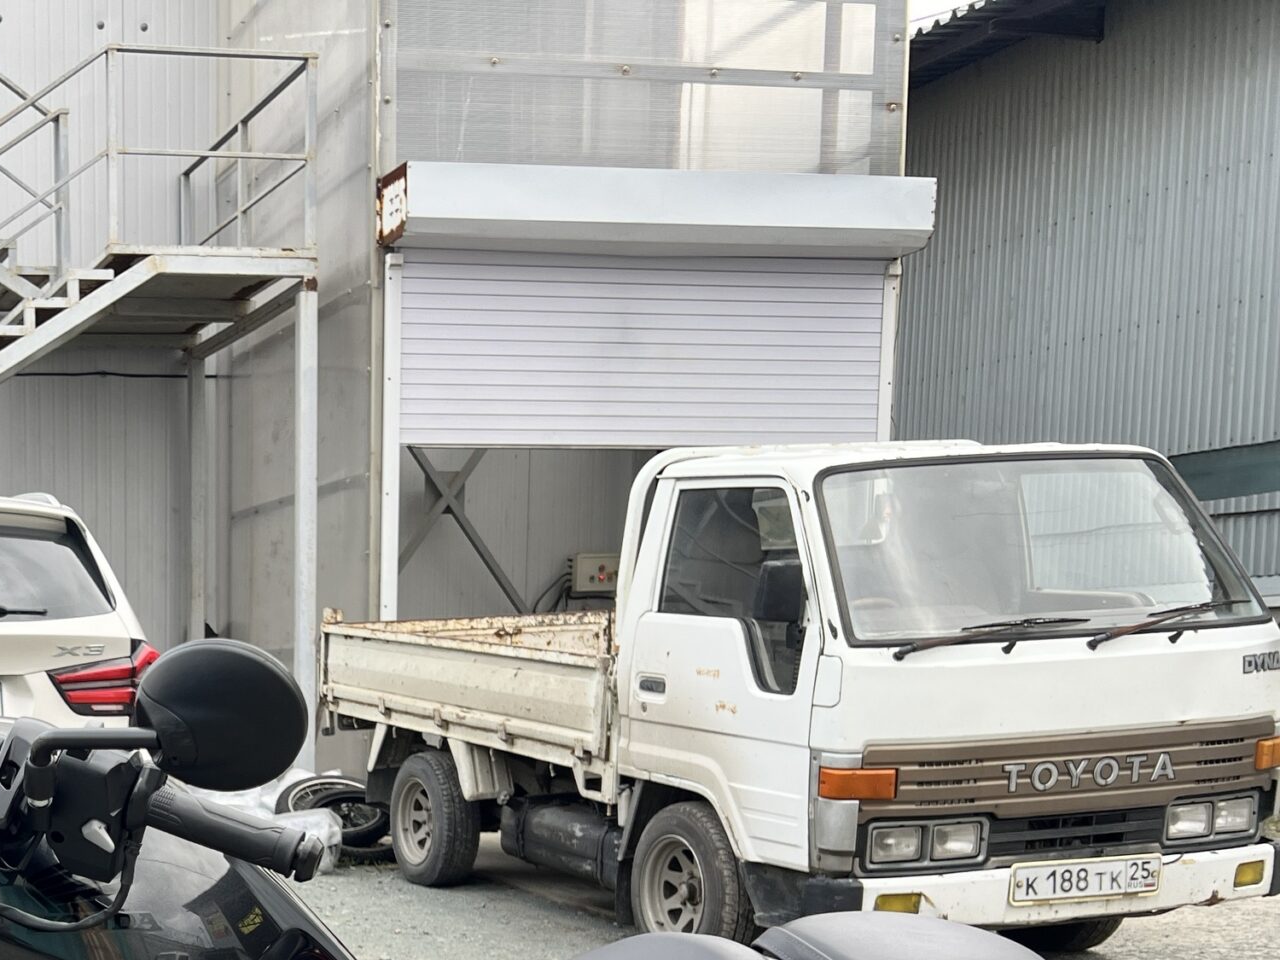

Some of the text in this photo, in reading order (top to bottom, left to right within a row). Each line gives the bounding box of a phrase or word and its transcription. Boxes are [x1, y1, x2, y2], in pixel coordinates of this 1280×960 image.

[53, 644, 106, 658] X3
[1002, 752, 1175, 793] TOYOTA
[1129, 861, 1151, 880] 25
